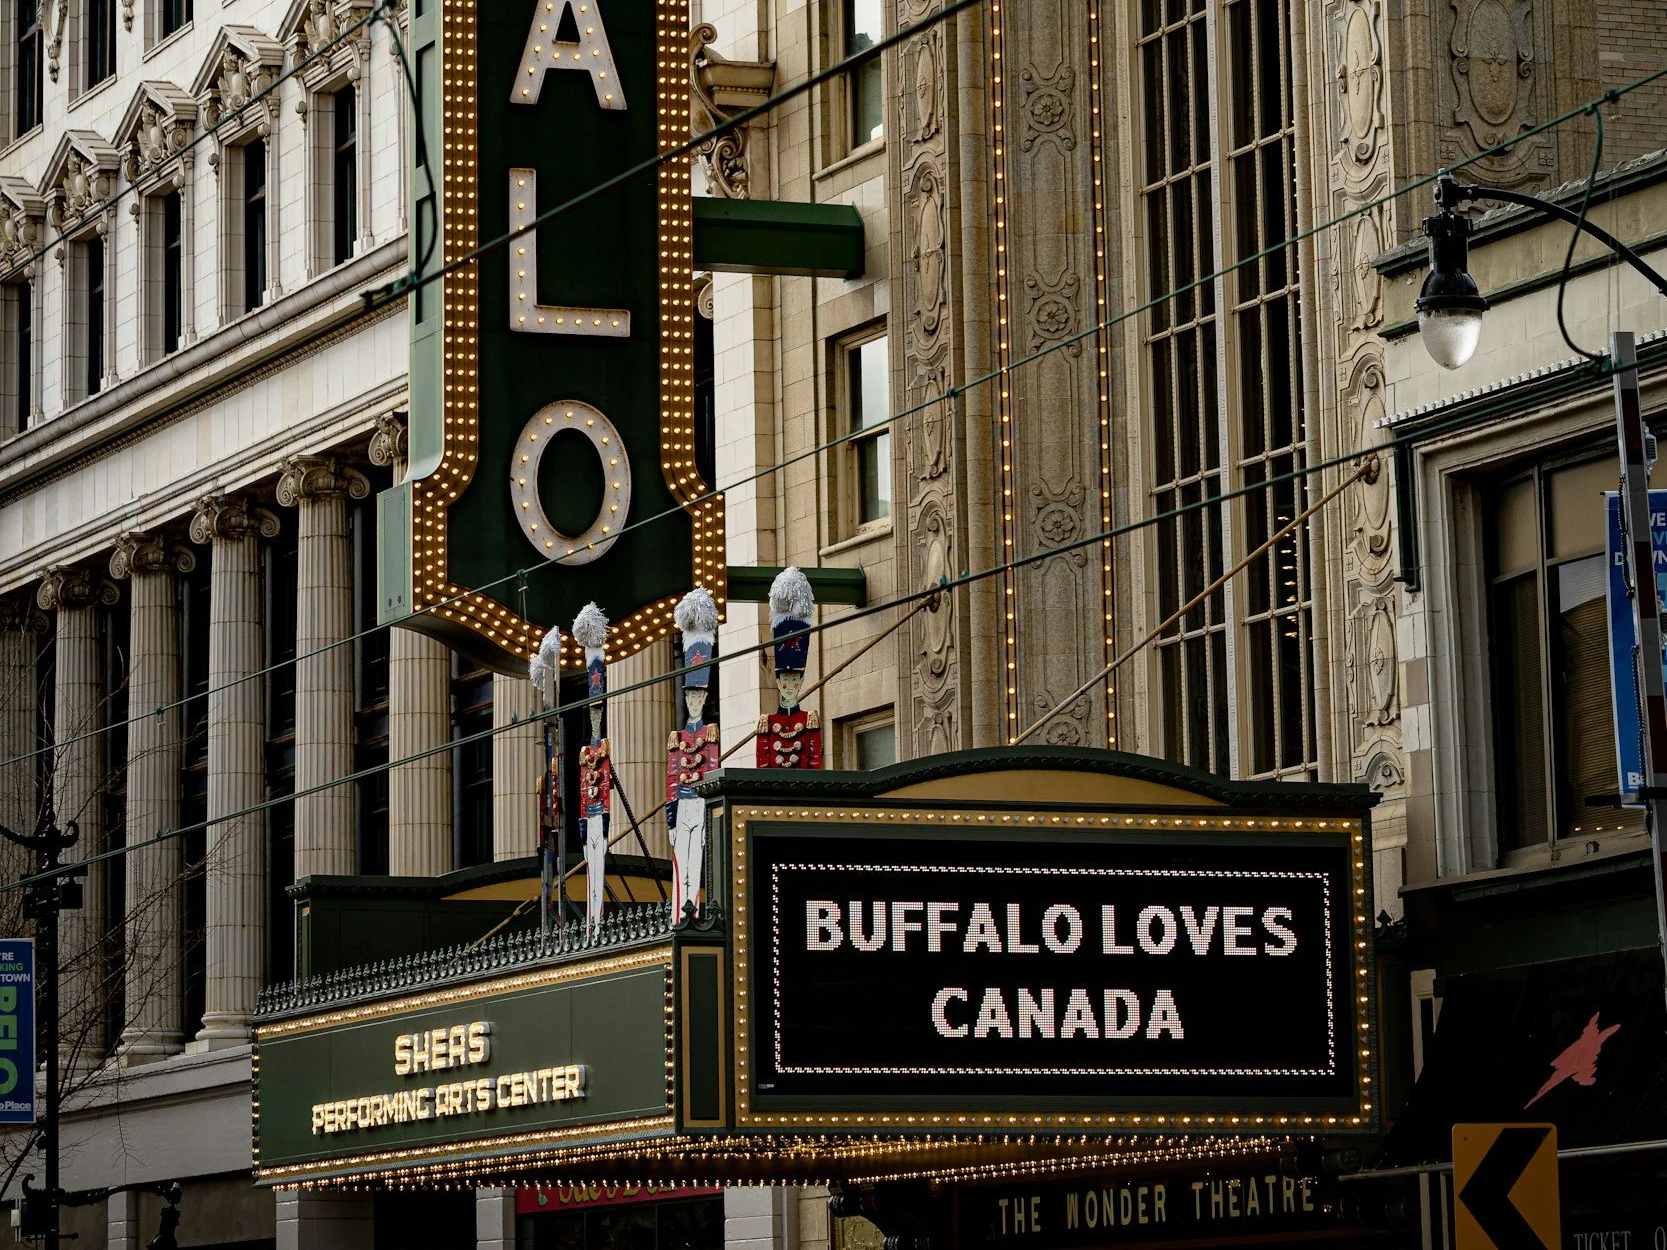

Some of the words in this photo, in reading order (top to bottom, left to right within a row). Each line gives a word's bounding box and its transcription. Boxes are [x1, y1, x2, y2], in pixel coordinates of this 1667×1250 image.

[805, 899, 1083, 954] BUFFALO
[1101, 904, 1298, 957] LOVES
[931, 986, 1185, 1040] CANADA
[394, 1021, 493, 1075] SHEAS
[312, 1086, 435, 1135] PERFORMING
[435, 1077, 496, 1117] ARTS
[496, 1063, 587, 1108] CENTER
[999, 1196, 1042, 1235] THE
[1066, 1183, 1167, 1231] WONDER
[1191, 1174, 1315, 1221] THEATRE
[1574, 1230, 1632, 1250] TICKET
